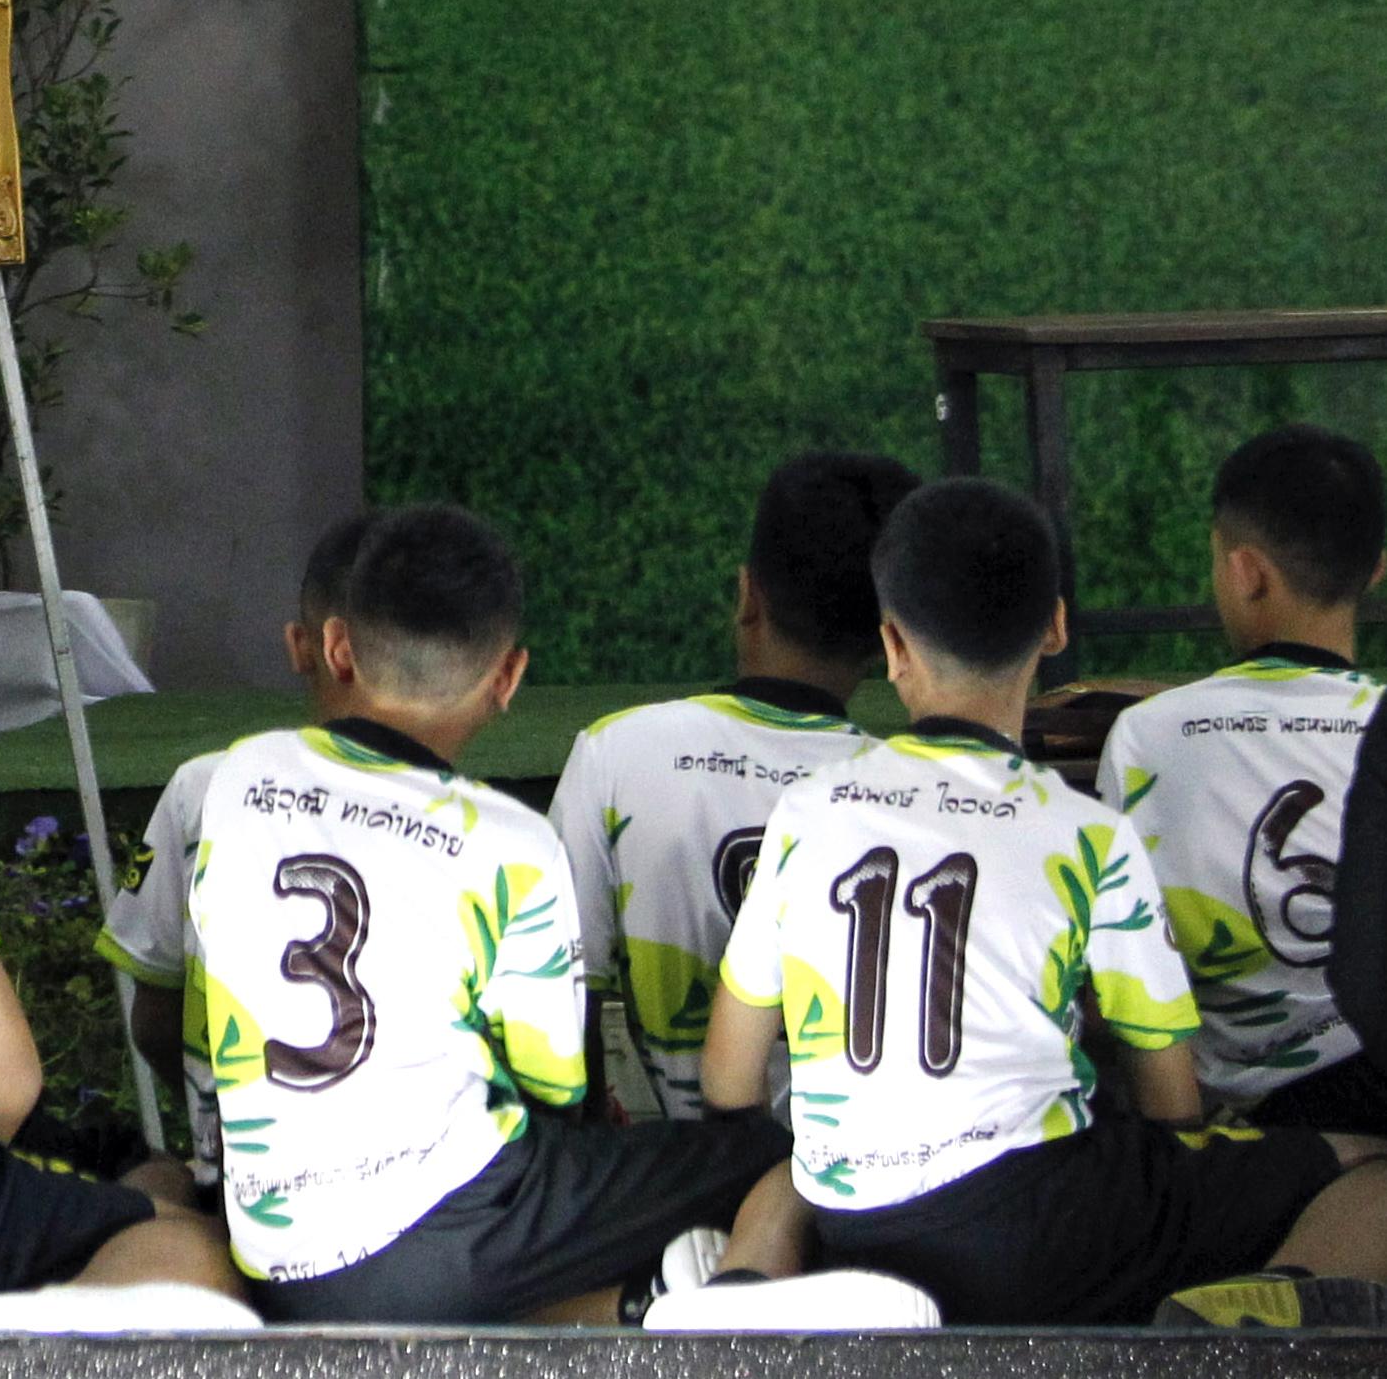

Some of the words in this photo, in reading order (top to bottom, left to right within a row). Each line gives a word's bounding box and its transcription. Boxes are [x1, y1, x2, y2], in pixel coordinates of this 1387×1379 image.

[243, 777, 329, 824] ณัฐวุฒิ
[340, 798, 464, 857] ทาคำทราย
[754, 764, 812, 786] วงค์
[830, 846, 978, 1078] 11
[1243, 779, 1338, 968] 6
[263, 853, 376, 1092] 3
